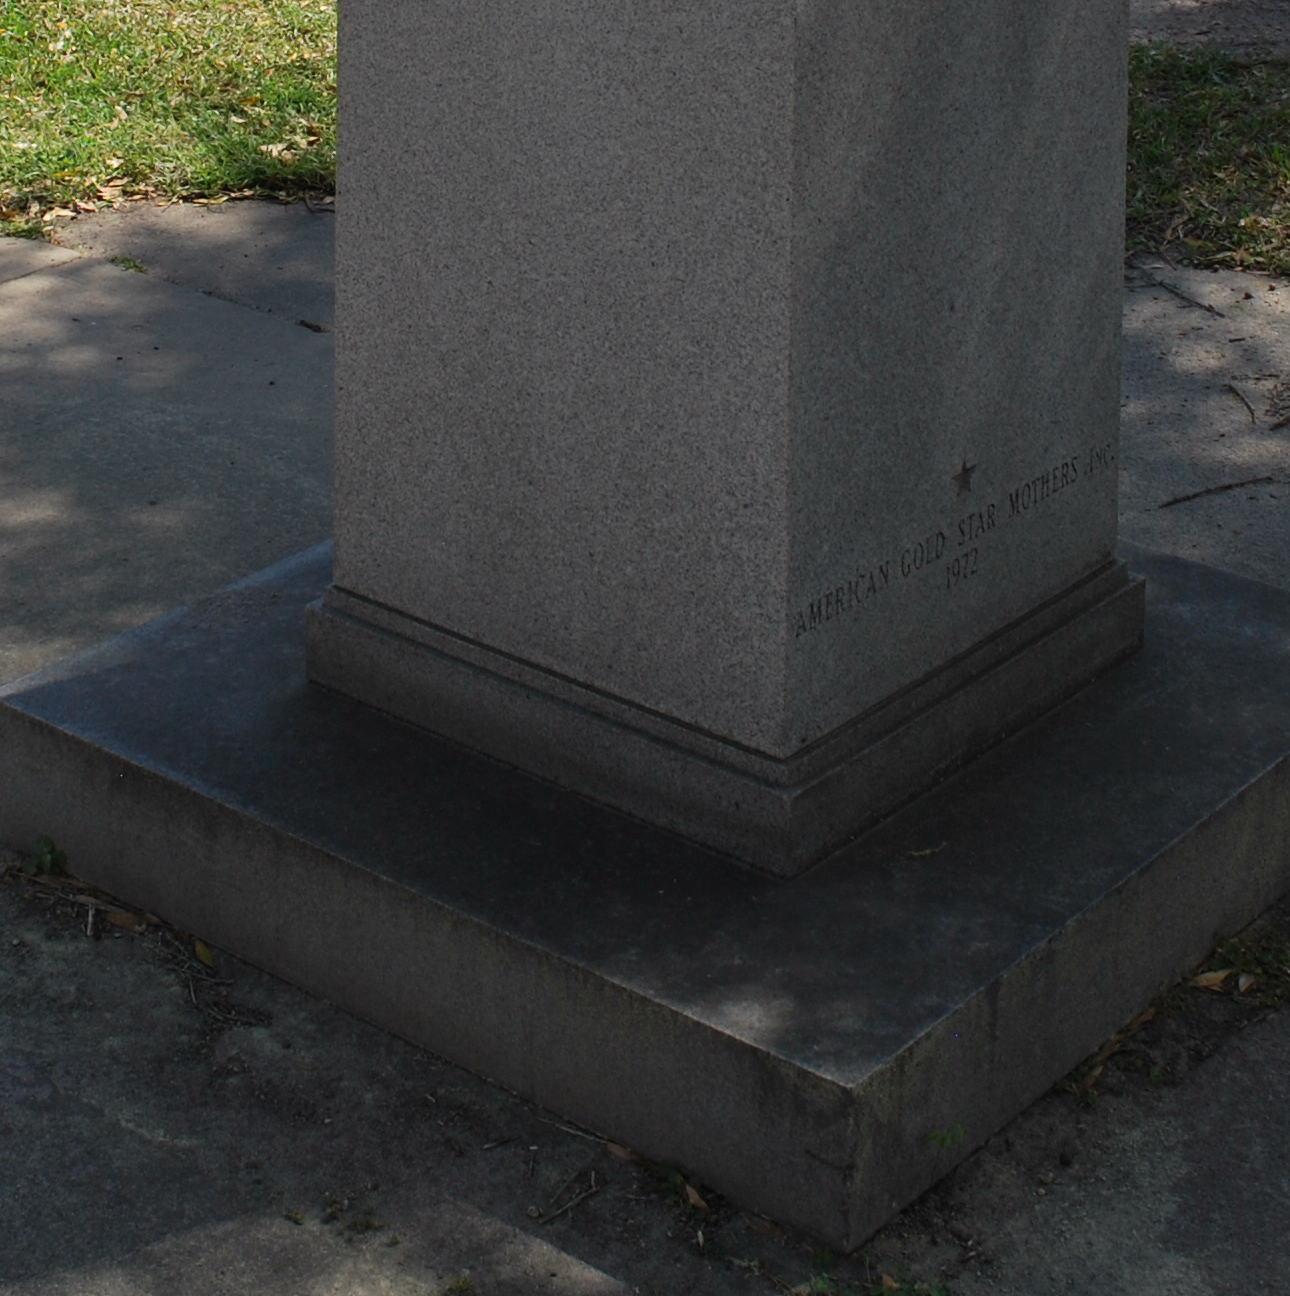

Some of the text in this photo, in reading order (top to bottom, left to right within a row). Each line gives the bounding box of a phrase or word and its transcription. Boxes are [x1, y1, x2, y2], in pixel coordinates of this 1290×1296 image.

[795, 561, 891, 638] AMERICAN
[900, 531, 946, 578] GOLD
[957, 502, 996, 546] STAR
[1007, 456, 1079, 519] MOTHERS
[944, 548, 980, 590] 1972
